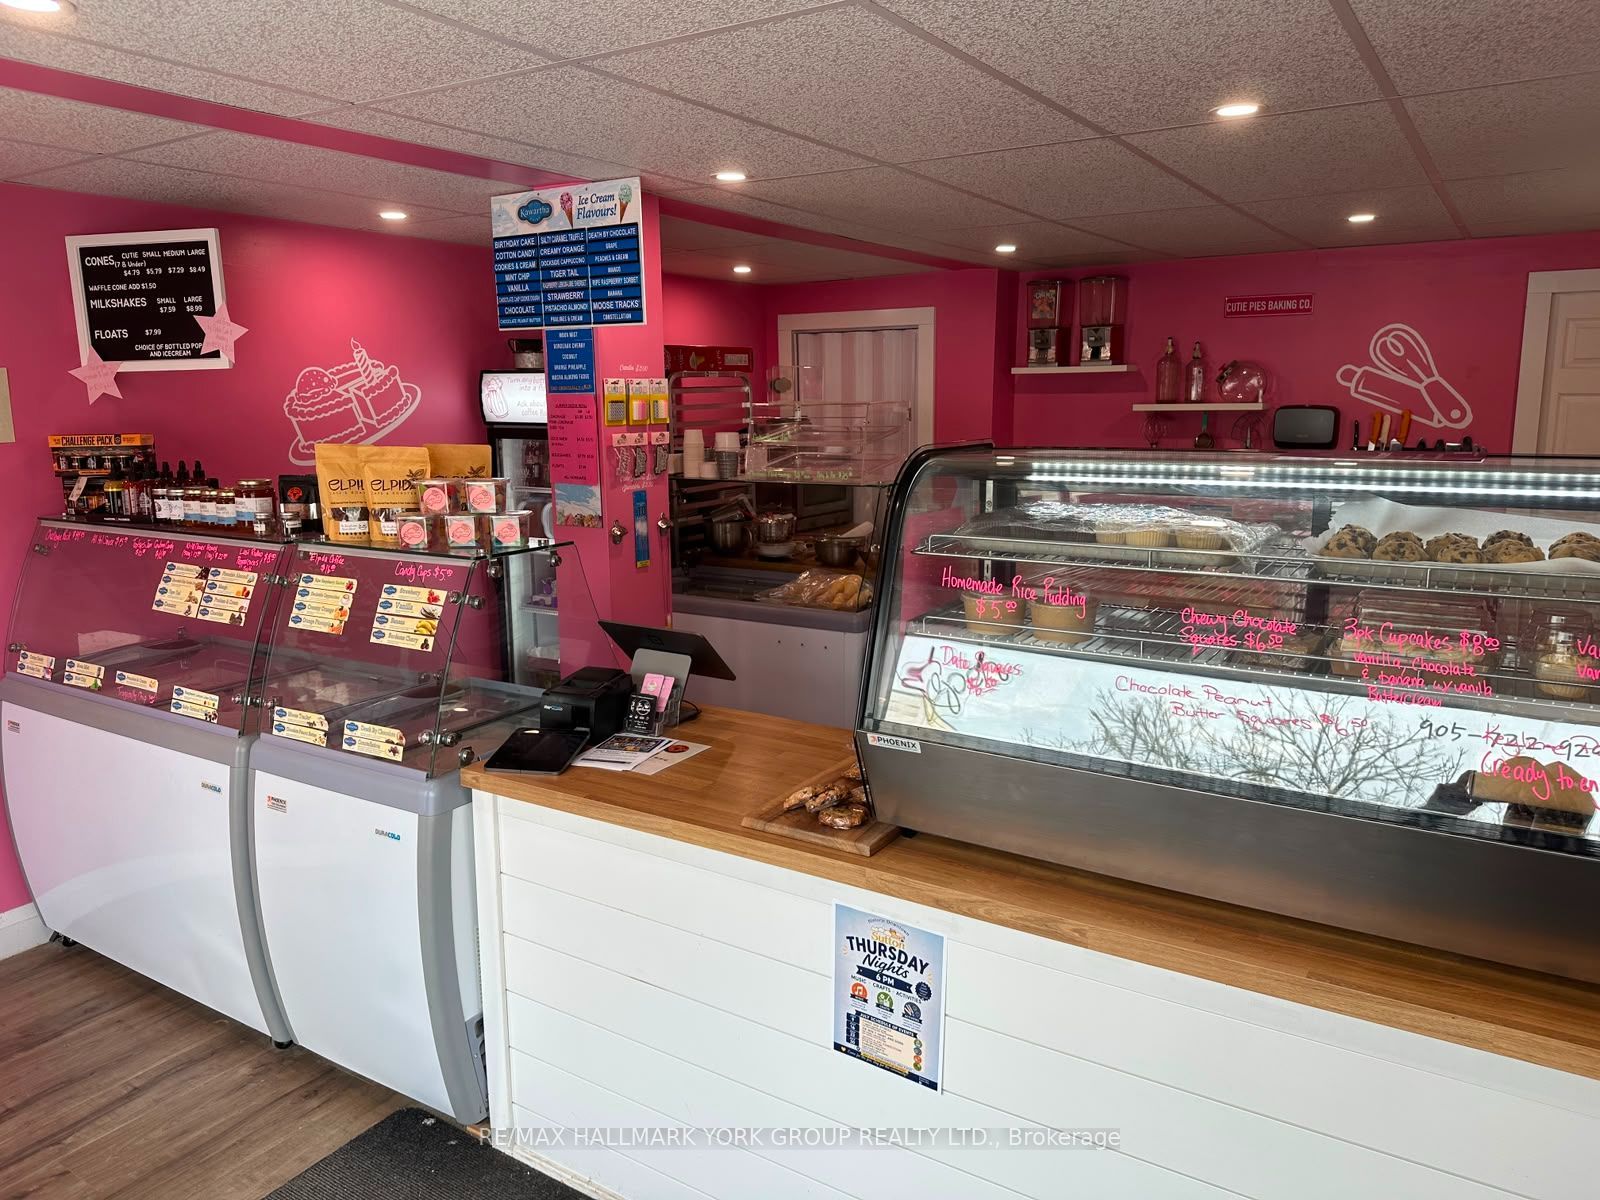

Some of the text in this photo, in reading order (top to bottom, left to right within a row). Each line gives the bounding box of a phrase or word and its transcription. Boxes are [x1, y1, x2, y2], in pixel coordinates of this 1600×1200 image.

[578, 194, 614, 205] Ice Cream
[520, 205, 550, 218] Kawartha
[577, 204, 616, 219] Flavours!
[568, 232, 584, 242] TRUFFLE
[588, 228, 636, 240] DEATH BY CHOCOLATE
[494, 238, 535, 248] BIRTHDAY CAKE
[496, 249, 535, 260] COTTON CANDY
[540, 245, 584, 256] CREAMY ORANGE
[85, 255, 115, 266] CONES
[128, 260, 146, 268] Under)
[495, 263, 514, 271] COOKIES
[520, 261, 536, 269] CREAM
[124, 269, 140, 277] $4.79
[168, 266, 184, 274] $7.29
[550, 270, 566, 278] TIGER
[141, 282, 156, 290] $1.50
[507, 284, 529, 292] VANILLA
[547, 291, 584, 301] STRAWBERRY
[90, 298, 147, 309] MILKSHAKES
[593, 300, 639, 310] MOOSE TRACKS
[1226, 300, 1312, 312] CUTIE PIES BAKING CO.
[504, 306, 535, 314] CHOCOLATE
[94, 329, 128, 339] FLOATS
[61, 436, 113, 446] CHALLENGE PACK
[328, 479, 364, 491] ELPI
[395, 562, 416, 582] Candy
[417, 564, 431, 582] Cups
[942, 565, 1087, 619] Homemade Rice Pudding
[1181, 607, 1297, 637] Chewy Chocolate
[1180, 626, 1237, 655] Squares
[1344, 618, 1375, 647] 3pk
[1380, 622, 1453, 653] Cupcakes
[1577, 634, 1600, 659] Va
[940, 646, 970, 670] Date
[1115, 675, 1272, 707] Chocolate Peanut
[1170, 701, 1224, 719] Butter
[1236, 710, 1312, 732] Squares
[877, 736, 917, 749] PHOENIX
[1557, 766, 1574, 790] to
[375, 828, 401, 841] DURACOLD
[871, 932, 905, 950] Sutton
[846, 936, 929, 975] THURSDAY
[862, 954, 909, 978] Nights
[876, 973, 895, 986] 6 PM
[851, 974, 922, 1004] MUSIC CRAFTS ACTIVITIES
